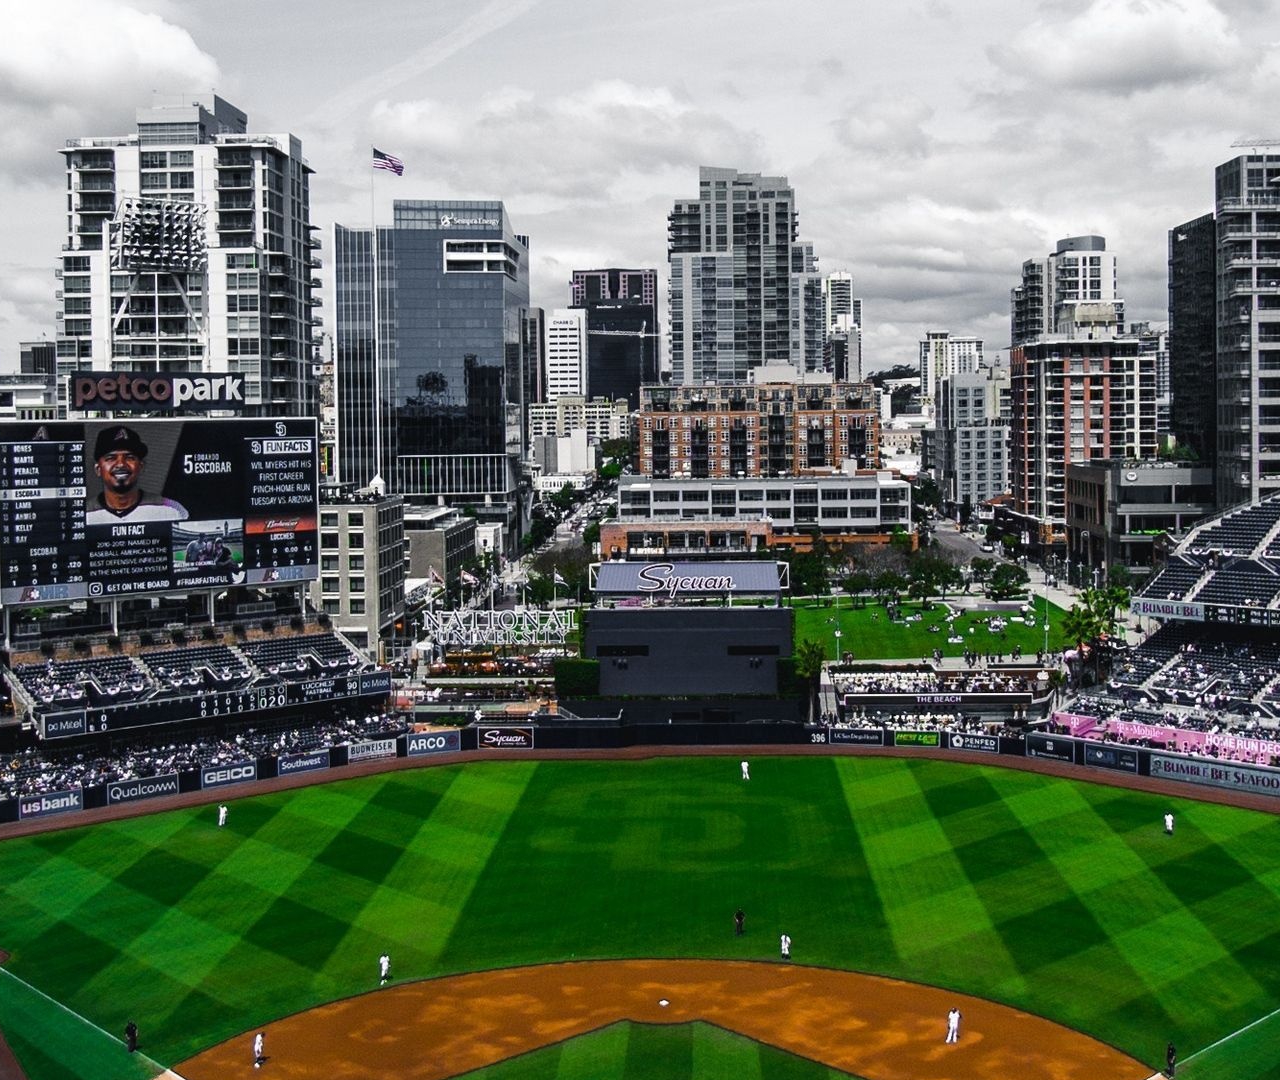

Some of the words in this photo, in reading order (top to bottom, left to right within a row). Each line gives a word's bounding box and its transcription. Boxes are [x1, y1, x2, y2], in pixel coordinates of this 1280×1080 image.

[266, 442, 283, 452] FUN
[284, 441, 308, 452] FACTS
[183, 454, 194, 474] 5
[194, 461, 232, 474] ESCOBAR
[265, 461, 288, 469] MYERS
[288, 460, 299, 468] HIT
[300, 460, 312, 468] HIS
[259, 472, 278, 481] FIRST
[278, 472, 304, 480] CAREER
[253, 484, 295, 493] PINCH-HOME
[296, 483, 311, 491] RUN
[251, 497, 277, 506] TUESDAY
[288, 494, 313, 503] ARIZONA
[111, 526, 127, 537] FUN
[128, 525, 146, 536] FACT
[30, 546, 58, 557] ESCOBAR
[89, 550, 119, 558] BASEBALL
[120, 548, 146, 556] AMERICA
[105, 557, 138, 567] DEFENSIVE
[98, 568, 110, 576] THE
[144, 565, 168, 573] SYSTEM
[107, 583, 120, 592] GET
[121, 582, 132, 590] ON
[133, 581, 146, 590] THE
[147, 580, 170, 589] BOARD
[177, 576, 228, 586] #FRIARFAITHFUL
[638, 563, 736, 598] Sycuan
[1142, 602, 1181, 617] BUMBLE
[422, 609, 580, 632] NATIONAL
[435, 629, 570, 646] UNIVERSITY
[301, 680, 336, 690] LUCCHESI
[347, 681, 358, 690] 90
[260, 688, 267, 697] B
[260, 697, 267, 709] 0
[269, 697, 276, 707] 2
[278, 695, 285, 706] 0
[934, 695, 962, 704] BEACH
[59, 719, 83, 731] Mitel
[409, 736, 446, 752] ARCO
[484, 731, 525, 745] Sycuan
[811, 733, 826, 743] 396
[964, 738, 996, 746] PENFED
[1205, 734, 1236, 749] HOME
[1236, 739, 1259, 752] RUN
[351, 741, 393, 755] BUDWEISER
[281, 756, 322, 771] Southwest
[204, 766, 254, 785] GEICO
[1164, 759, 1209, 779] BUMBLE
[1211, 768, 1232, 782] BEE
[110, 781, 177, 800] Qualcomm
